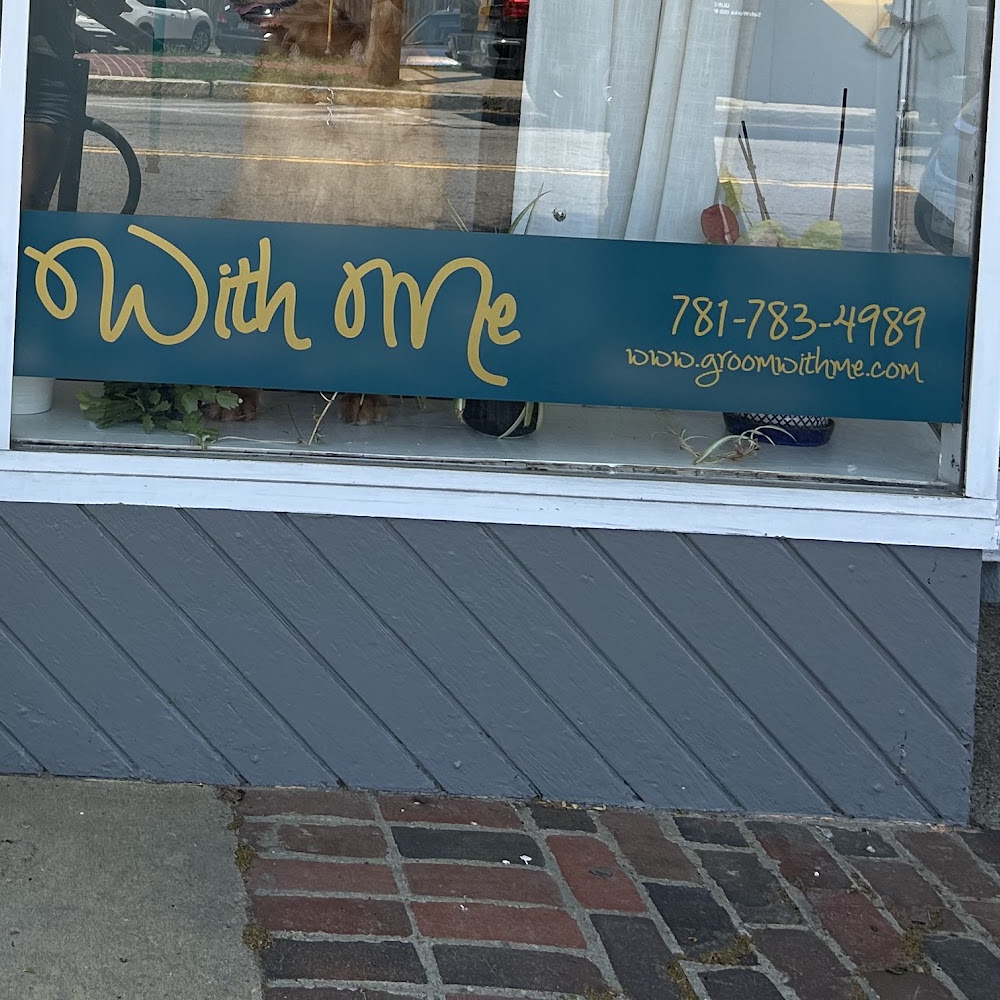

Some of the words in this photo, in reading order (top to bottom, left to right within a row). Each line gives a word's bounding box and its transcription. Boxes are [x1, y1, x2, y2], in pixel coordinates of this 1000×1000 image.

[24, 224, 312, 350] With
[333, 257, 522, 387] Me
[671, 294, 927, 349] 781-783-4989
[626, 346, 924, 387] www.groomwithme.com
